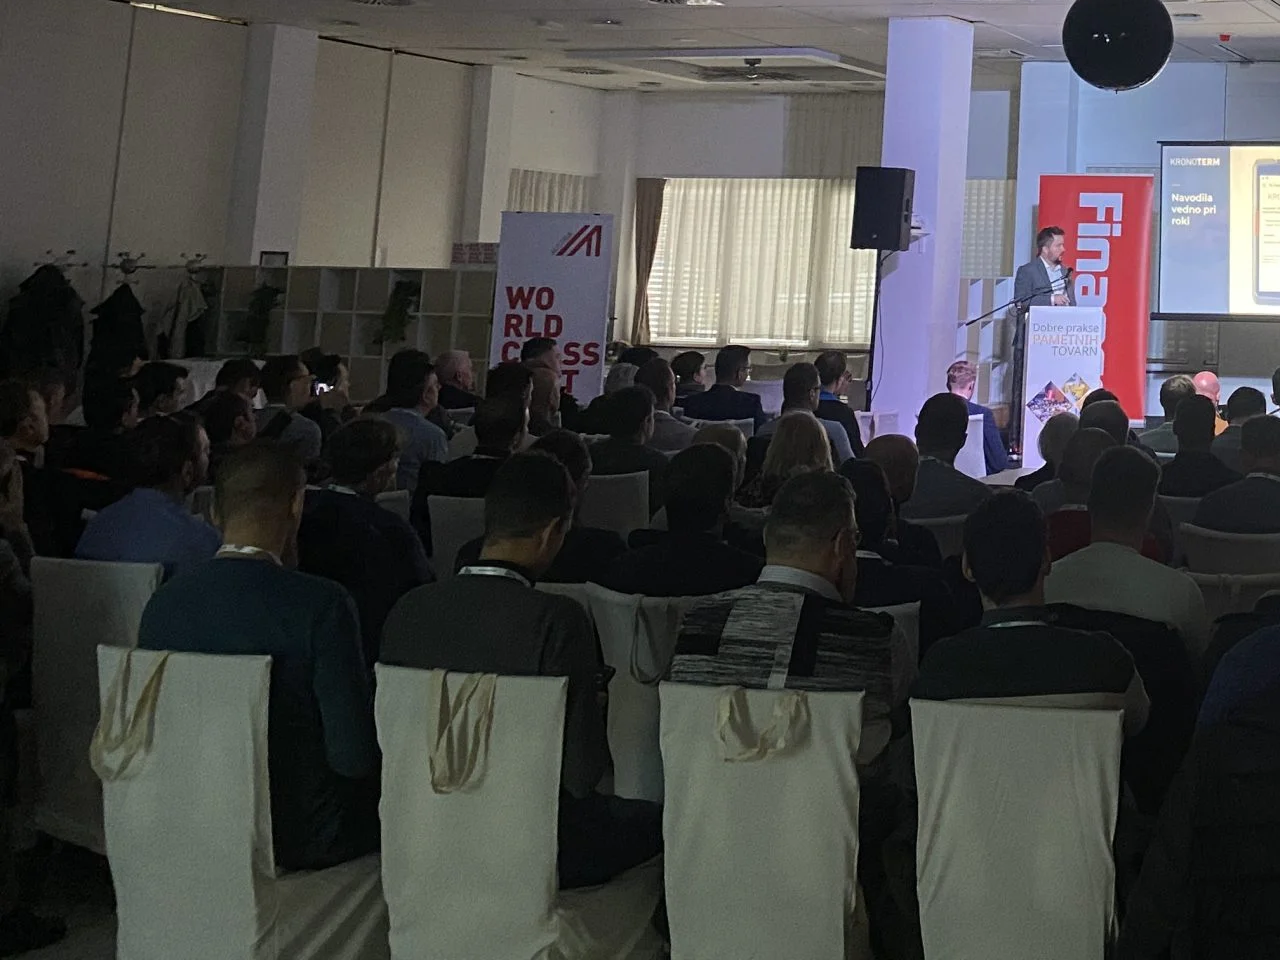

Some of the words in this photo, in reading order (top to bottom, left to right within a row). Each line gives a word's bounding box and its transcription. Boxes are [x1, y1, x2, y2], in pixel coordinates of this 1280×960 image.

[1170, 157, 1220, 166] KRONOTERM
[1171, 193, 1213, 203] Navodila
[1171, 205, 1201, 214] vedno
[1203, 205, 1216, 216] pri
[1171, 216, 1190, 226] roki
[1075, 192, 1123, 388] Fina
[505, 286, 555, 310] WO
[504, 313, 563, 338] RLD
[1032, 323, 1063, 333] Dobre
[1066, 323, 1099, 336] prakse
[1033, 334, 1099, 345] PAMETNIH
[501, 341, 600, 366] CSS
[1052, 346, 1098, 356] TOVARN
